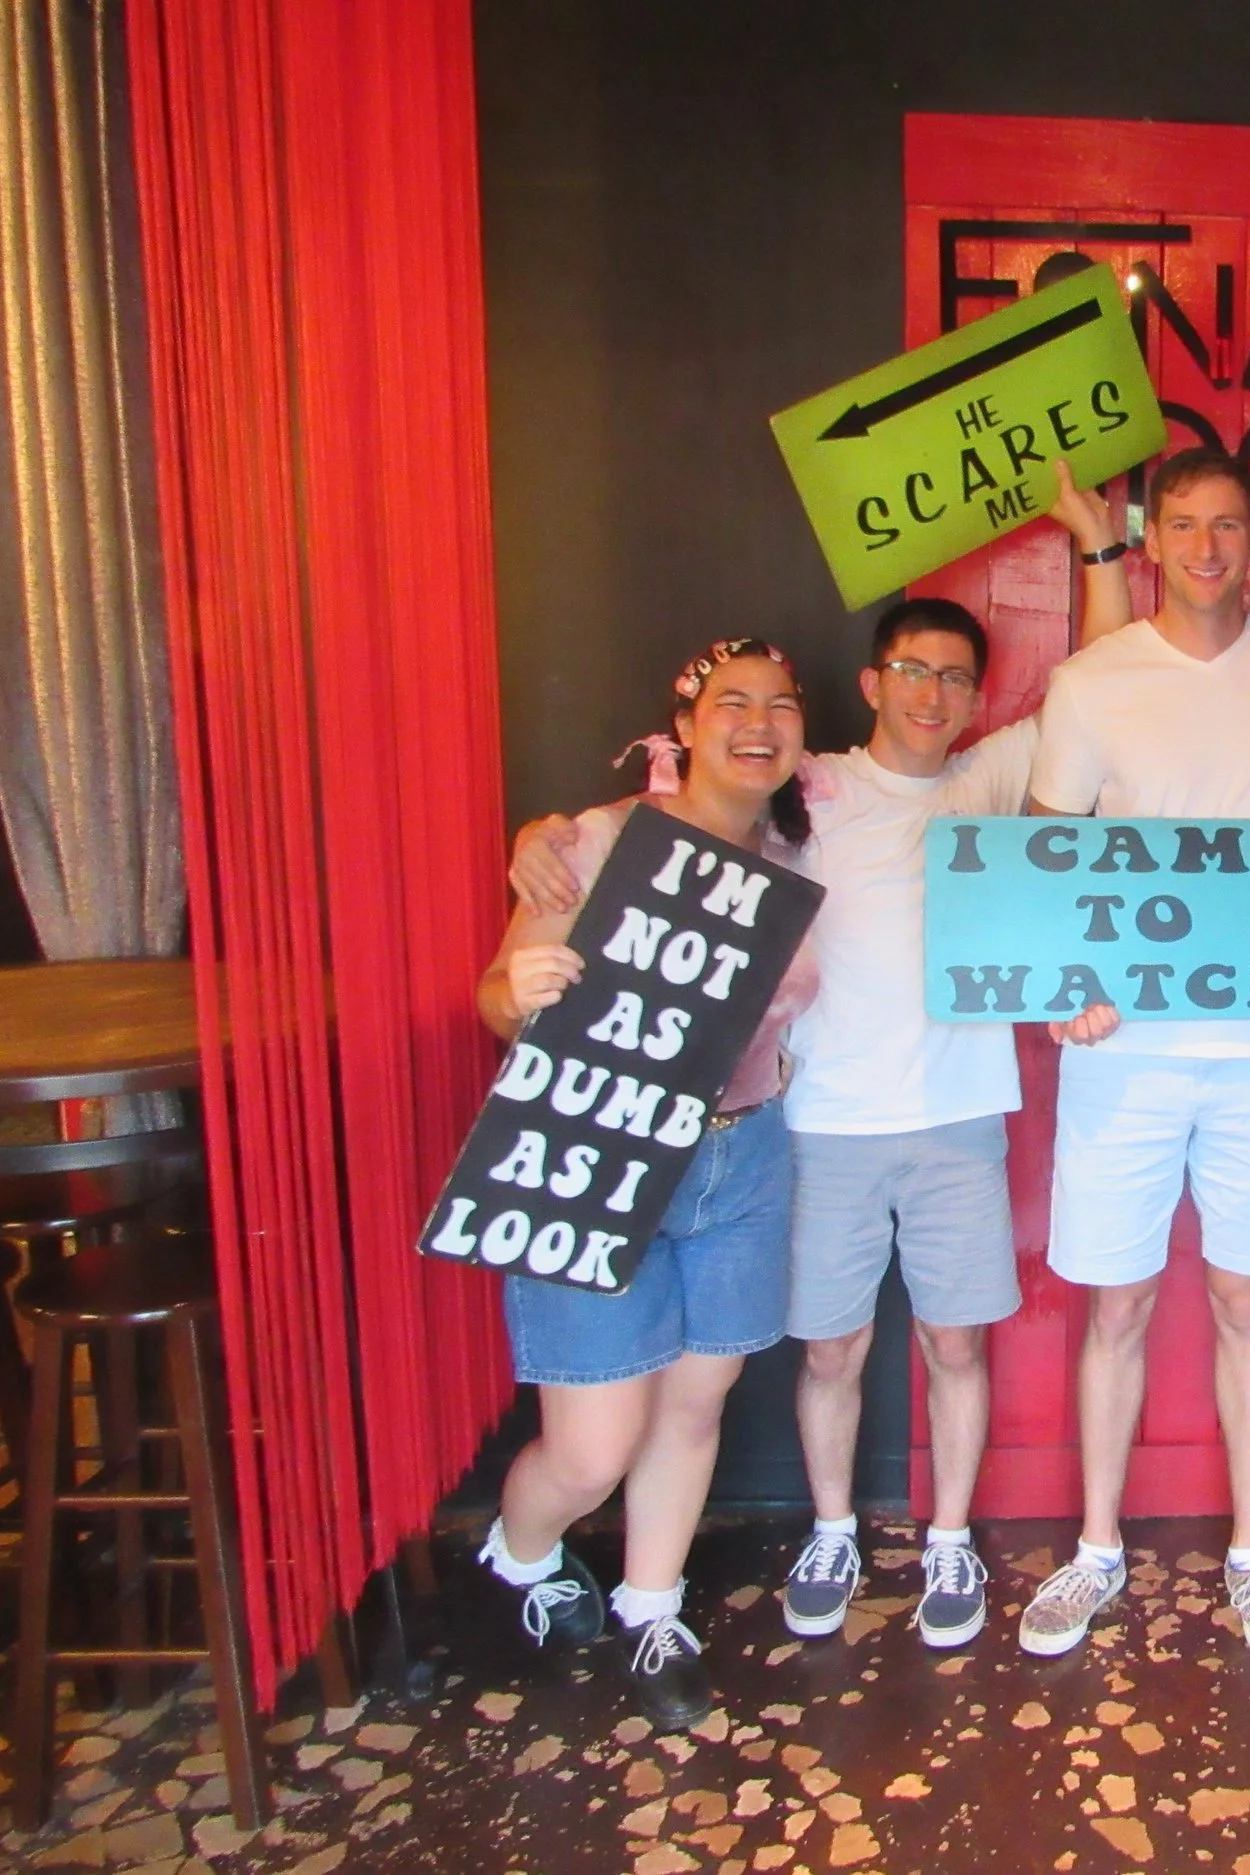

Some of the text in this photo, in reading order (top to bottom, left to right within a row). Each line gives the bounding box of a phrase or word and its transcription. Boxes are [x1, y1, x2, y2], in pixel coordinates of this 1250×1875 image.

[955, 394, 1003, 440] HE
[857, 381, 1129, 551] SCARES
[985, 481, 1039, 529] ME
[652, 839, 771, 928] I'M
[947, 825, 987, 873] I
[603, 906, 750, 1000] NOT
[1075, 894, 1193, 943] TO
[586, 991, 692, 1061] AS
[494, 1042, 707, 1148] DUMB
[489, 1130, 650, 1213] AS I
[432, 1197, 629, 1289] LOOK
